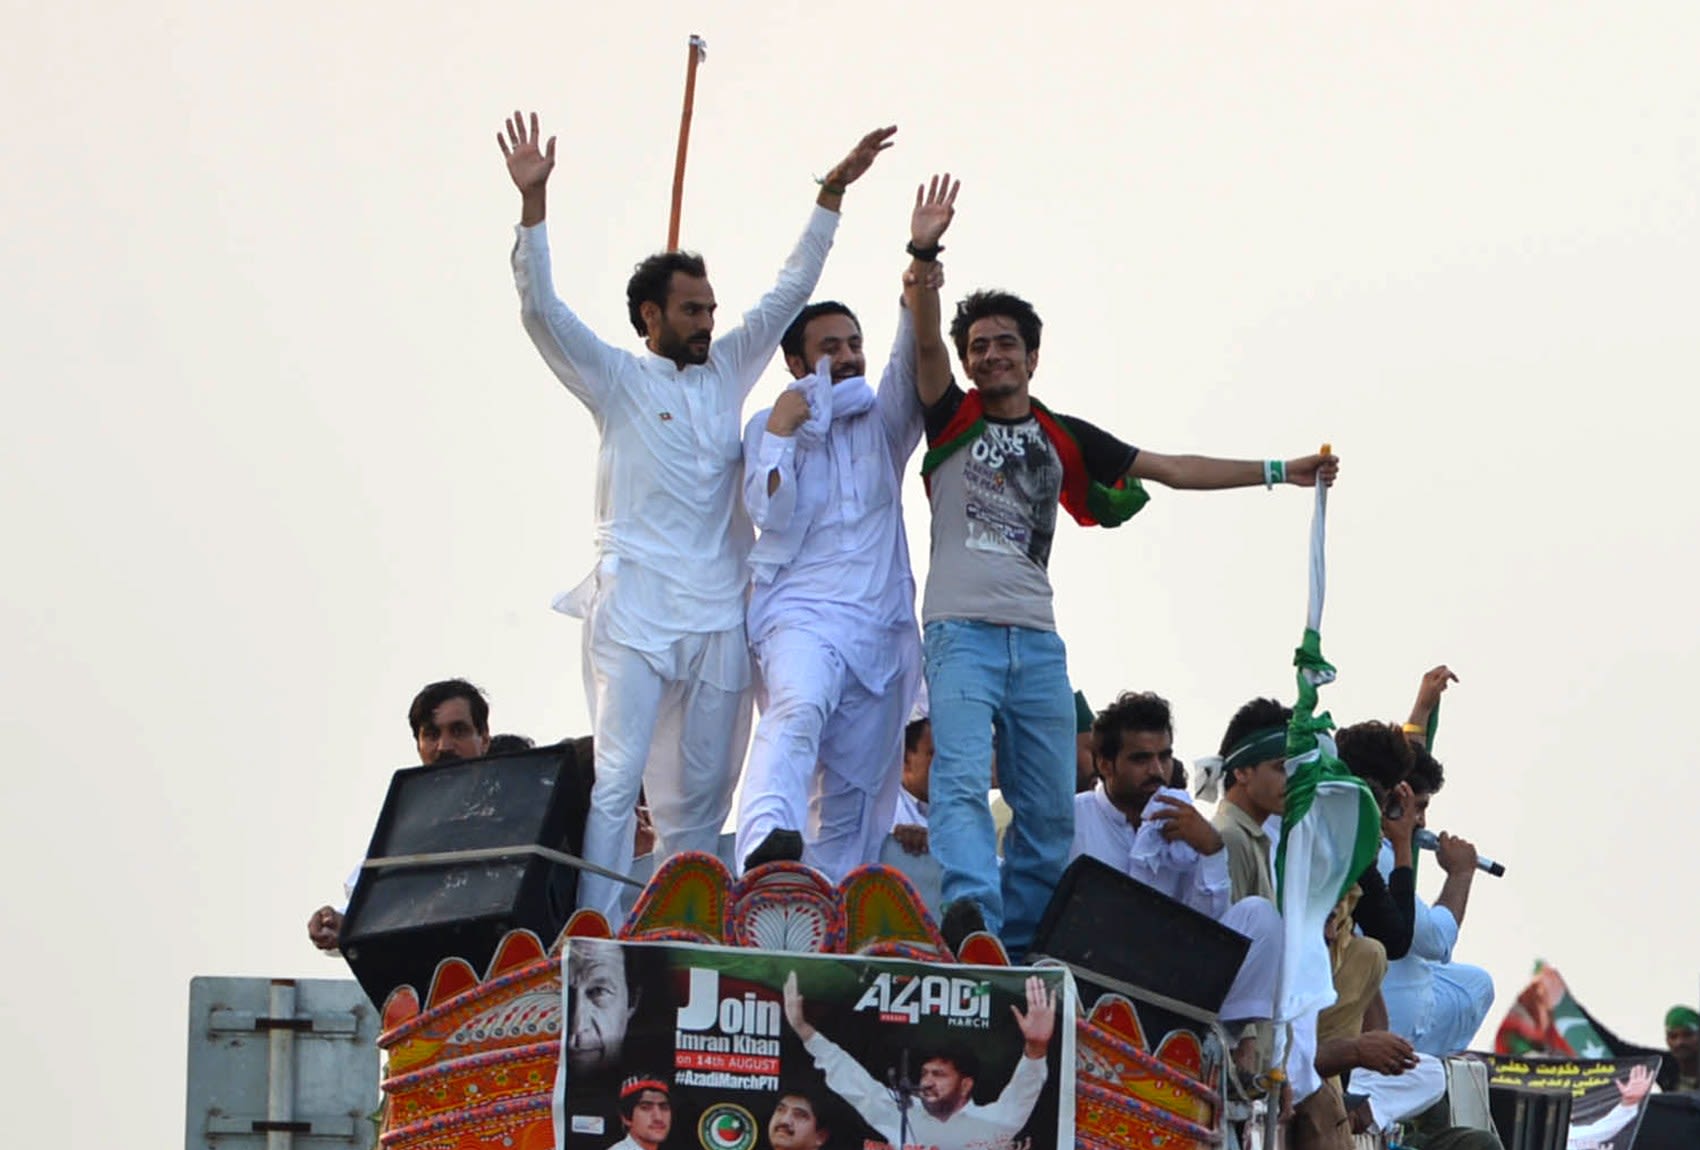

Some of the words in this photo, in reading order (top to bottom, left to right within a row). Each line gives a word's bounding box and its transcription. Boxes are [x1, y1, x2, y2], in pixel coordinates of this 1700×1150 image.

[677, 967, 781, 1036] Join
[853, 972, 991, 1024] AZADI
[948, 1017, 990, 1029] MARCH
[676, 1030, 730, 1053] Imran
[732, 1034, 780, 1057] Khan
[676, 1055, 692, 1066] on
[729, 1056, 778, 1071] AUGUST
[675, 1069, 780, 1091] #AzadiMarchPTI
